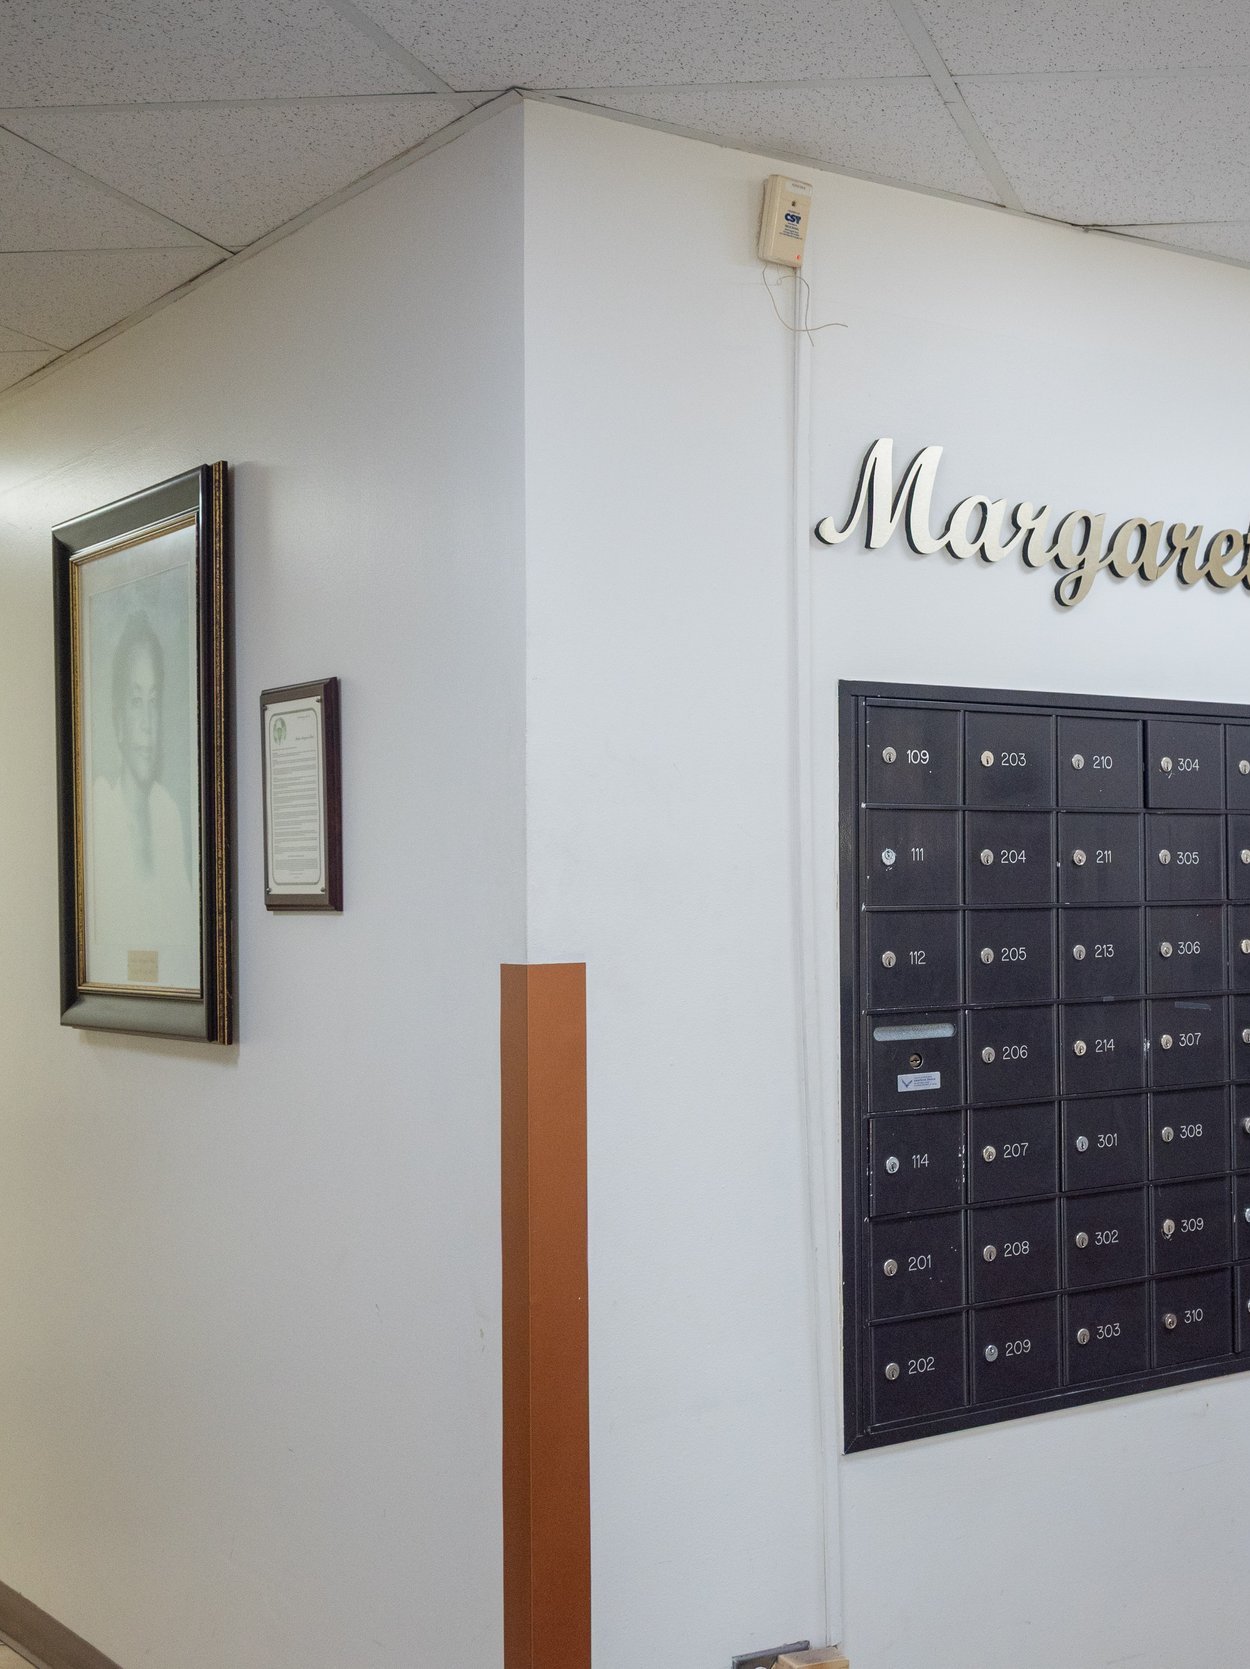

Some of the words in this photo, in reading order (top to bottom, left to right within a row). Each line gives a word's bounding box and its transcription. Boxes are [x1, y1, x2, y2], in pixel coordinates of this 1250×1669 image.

[907, 750, 929, 764] 109
[1002, 752, 1026, 766] 203
[1093, 756, 1112, 769] 210
[1178, 758, 1199, 771] 304
[911, 848, 923, 861] 111
[1001, 850, 1026, 863] 204
[1096, 850, 1111, 863] 211
[1177, 852, 1199, 864] 305
[1002, 947, 1026, 961] 205
[1095, 945, 1114, 957] 213
[1178, 941, 1200, 954] 306
[910, 951, 925, 964] 112
[1096, 1039, 1115, 1052] 214
[1179, 1033, 1201, 1046] 307
[1003, 1045, 1027, 1059] 206
[1180, 1124, 1202, 1138] 308
[1098, 1133, 1117, 1147] 301
[1004, 1143, 1028, 1158] 207
[912, 1154, 928, 1168] 114
[1181, 1218, 1203, 1232] 309
[1095, 1230, 1118, 1245] 302
[1004, 1241, 1029, 1257] 208
[909, 1255, 931, 1271] 201
[1185, 1309, 1203, 1323] 310
[1097, 1323, 1120, 1339] 303
[1006, 1339, 1030, 1356] 209
[909, 1357, 935, 1374] 202
